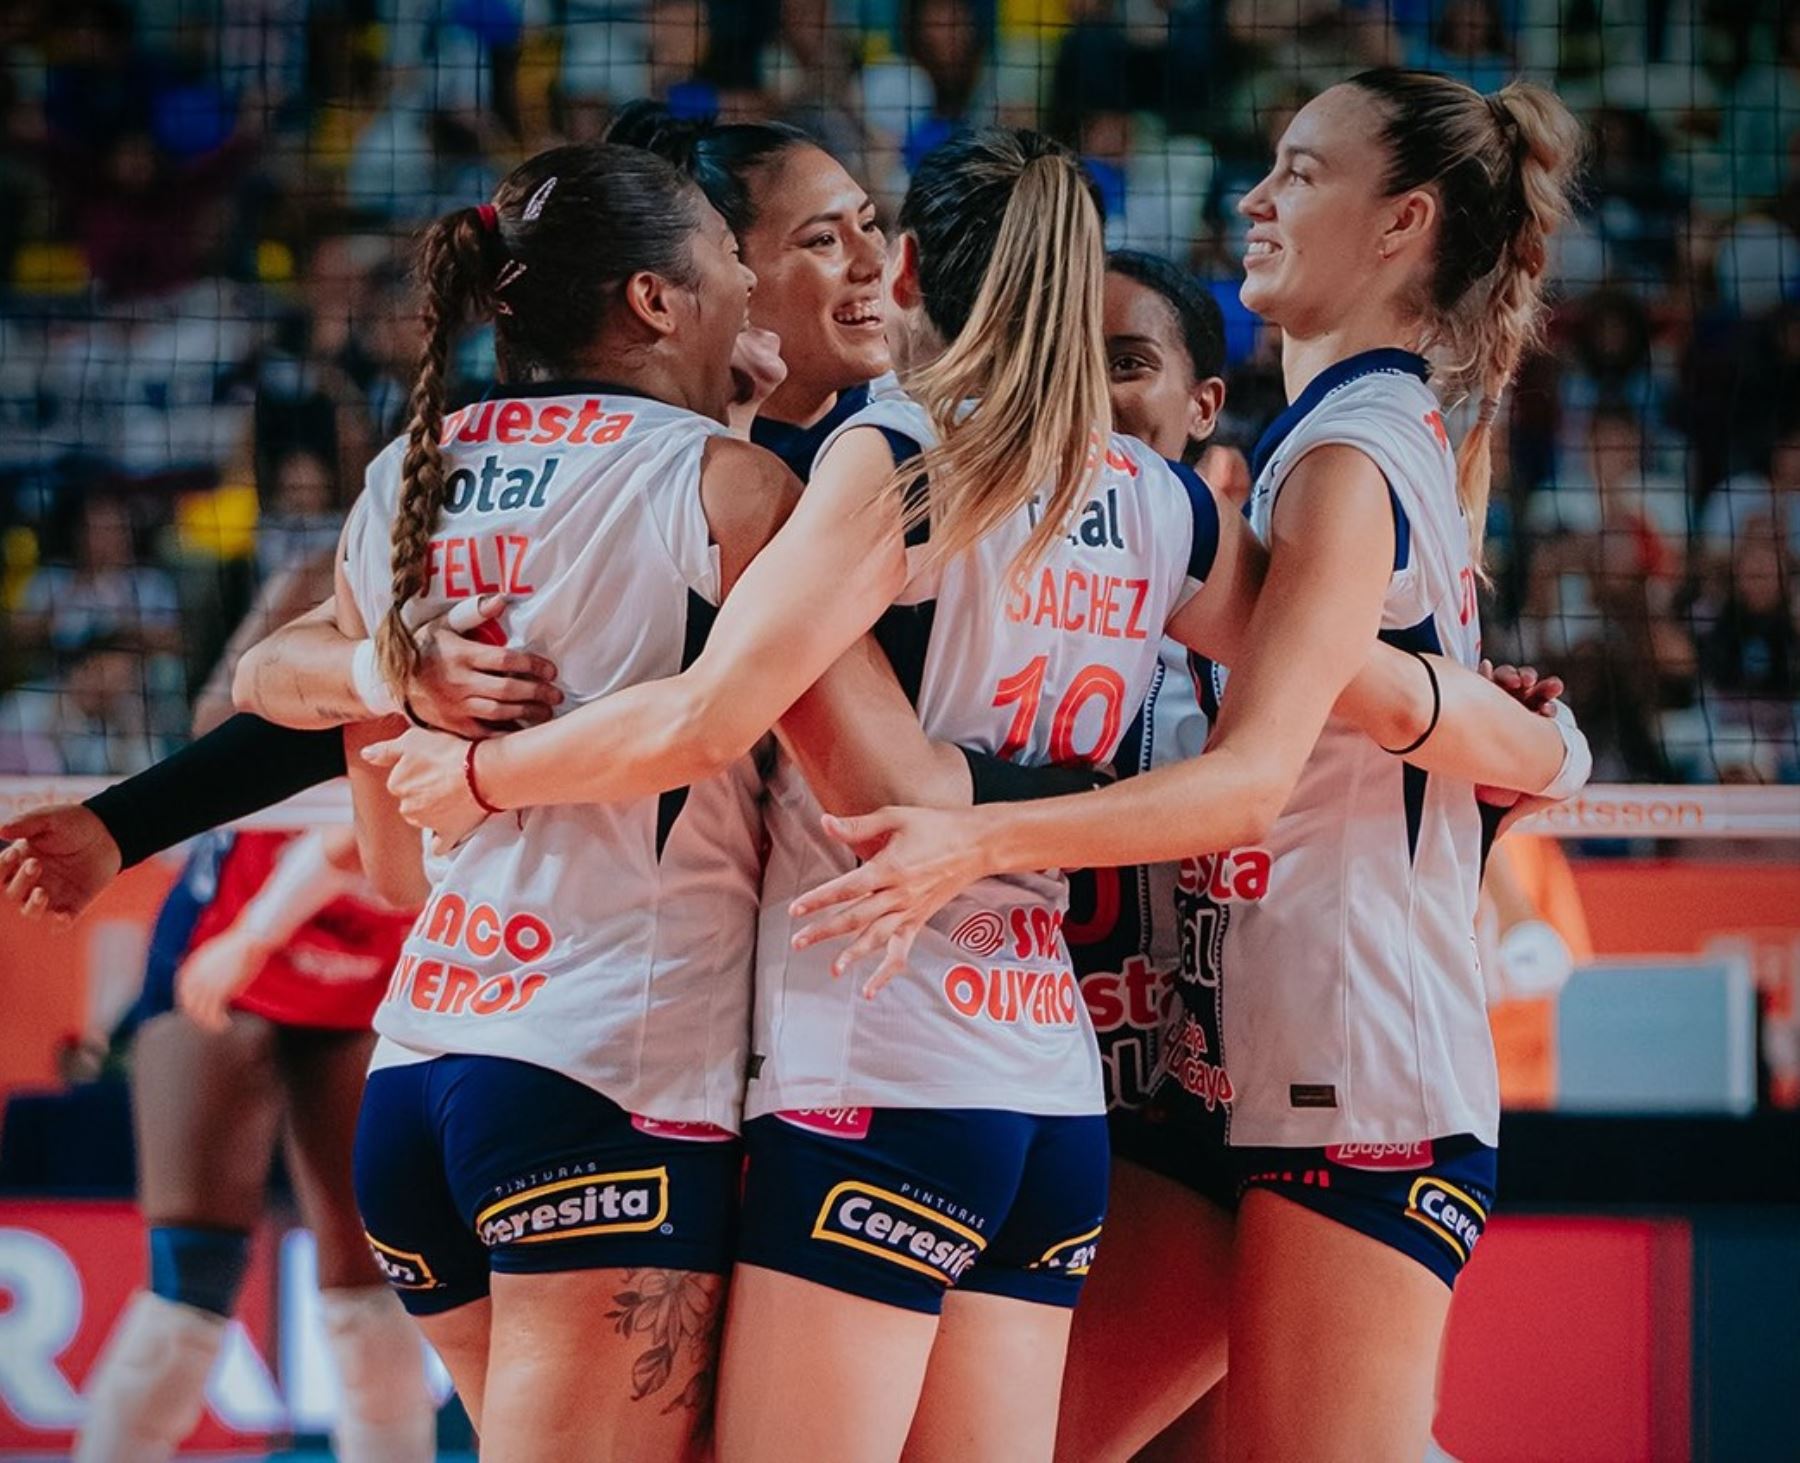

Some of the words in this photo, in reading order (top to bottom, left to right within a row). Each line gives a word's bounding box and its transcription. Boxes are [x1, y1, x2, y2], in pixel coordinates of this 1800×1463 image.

[442, 453, 560, 515] otal
[421, 533, 534, 599] FELIZ
[1005, 565, 1150, 640] SACHEZ
[992, 655, 1126, 766] 10
[416, 891, 554, 964] ACO
[900, 1182, 986, 1230] PINTURAS
[1421, 1188, 1481, 1251] Cere
